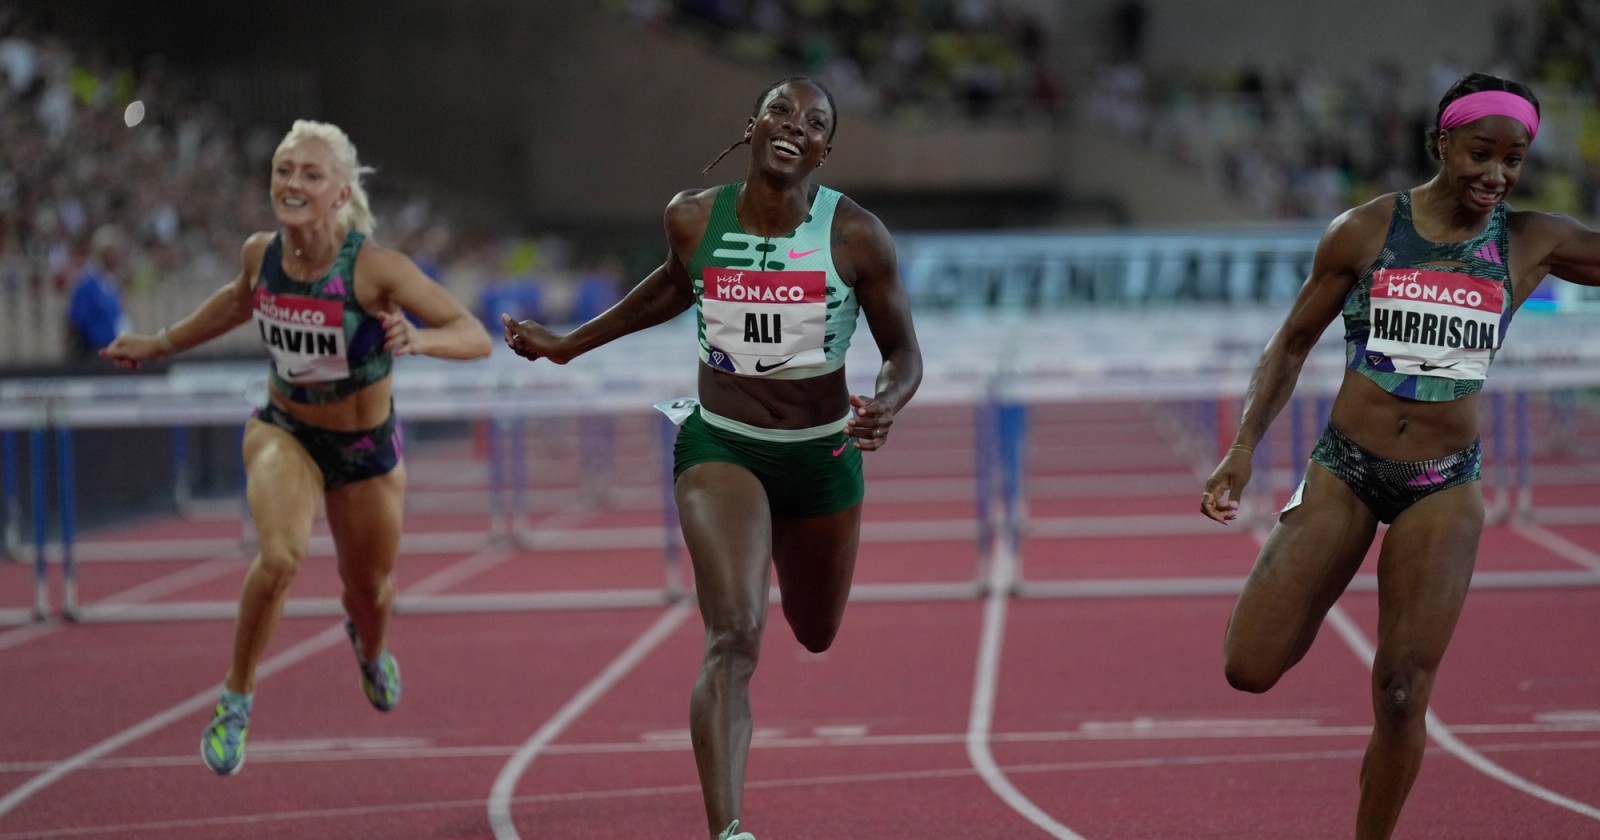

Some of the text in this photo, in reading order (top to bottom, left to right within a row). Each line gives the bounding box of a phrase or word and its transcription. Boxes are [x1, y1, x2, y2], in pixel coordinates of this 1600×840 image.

[717, 272, 745, 283] visit
[1389, 271, 1421, 282] visit
[716, 284, 804, 302] MONACO
[1387, 283, 1482, 307] MONACO
[260, 302, 326, 326] MONACO
[258, 319, 338, 355] LAVIN
[743, 313, 782, 344] ALI
[1373, 308, 1495, 349] HARRISON
